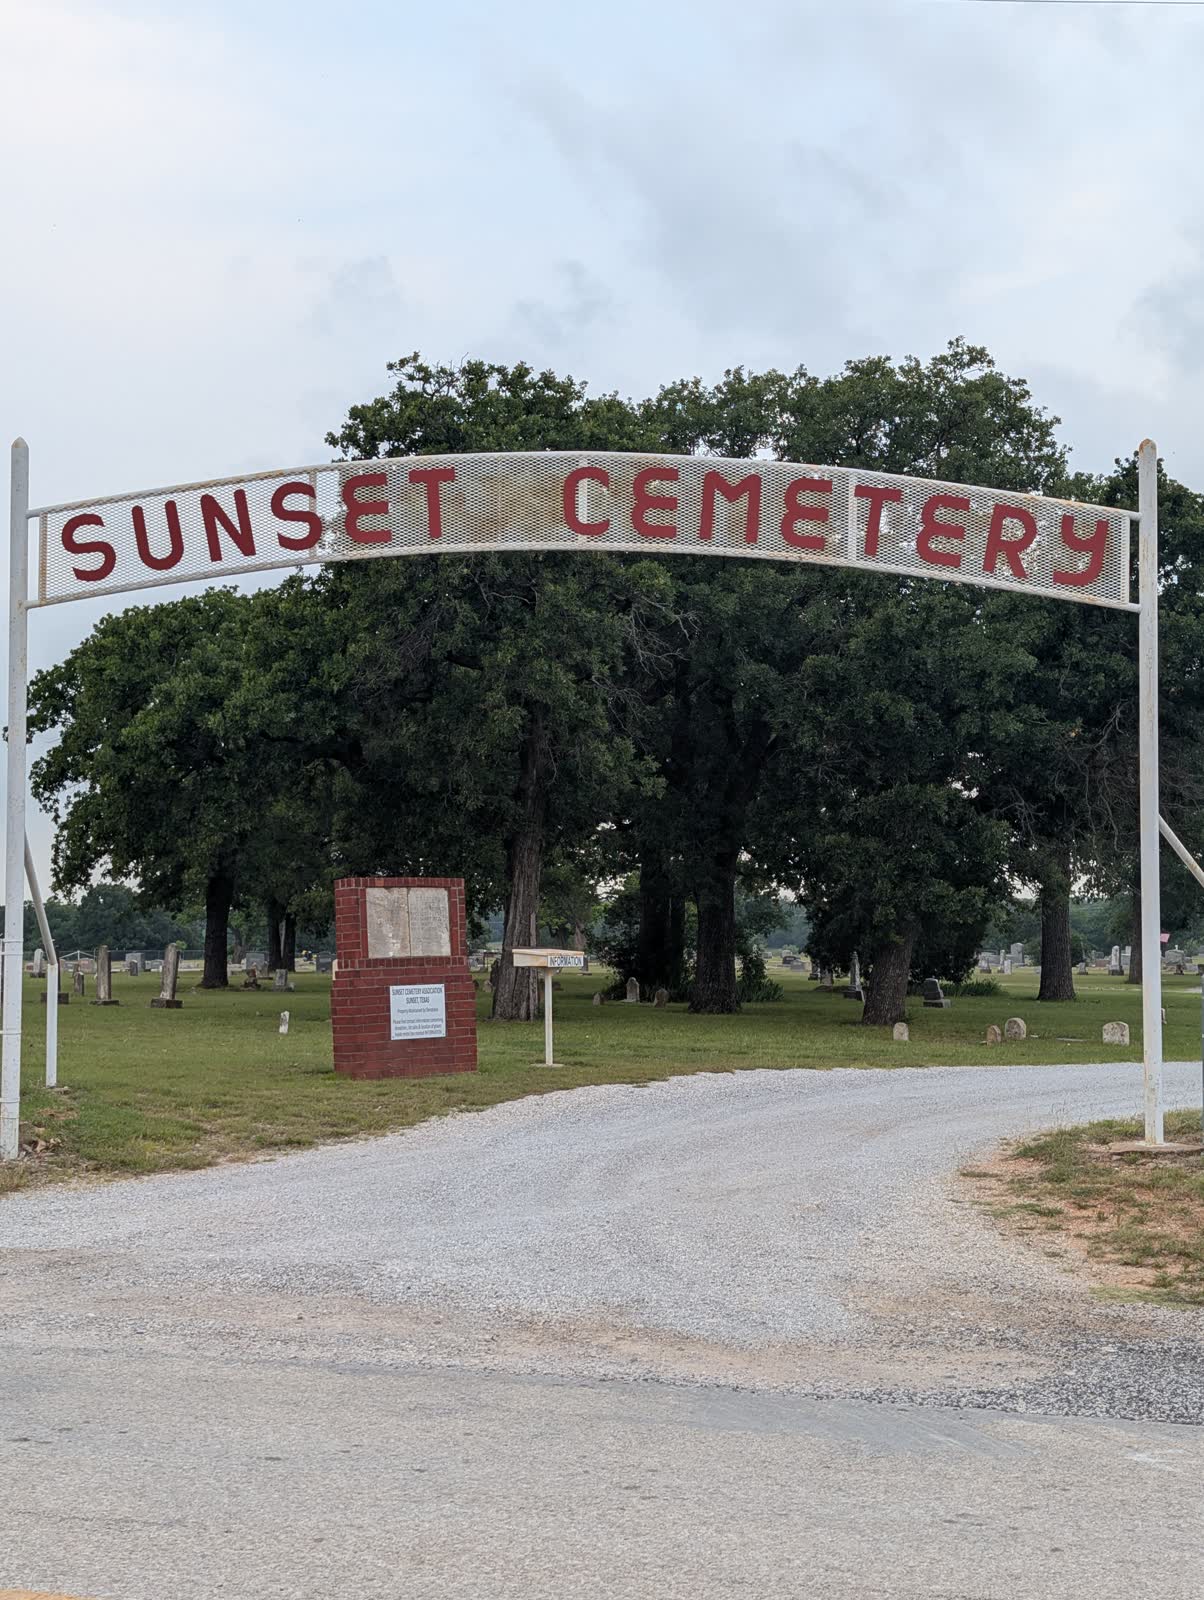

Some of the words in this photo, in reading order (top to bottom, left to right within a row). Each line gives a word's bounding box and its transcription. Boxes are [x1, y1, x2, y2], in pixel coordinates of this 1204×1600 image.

[61, 467, 456, 582] SUNSET
[563, 466, 1109, 587] CEMETERY
[549, 956, 582, 966] INFORMATION
[392, 988, 404, 996] SUNSET
